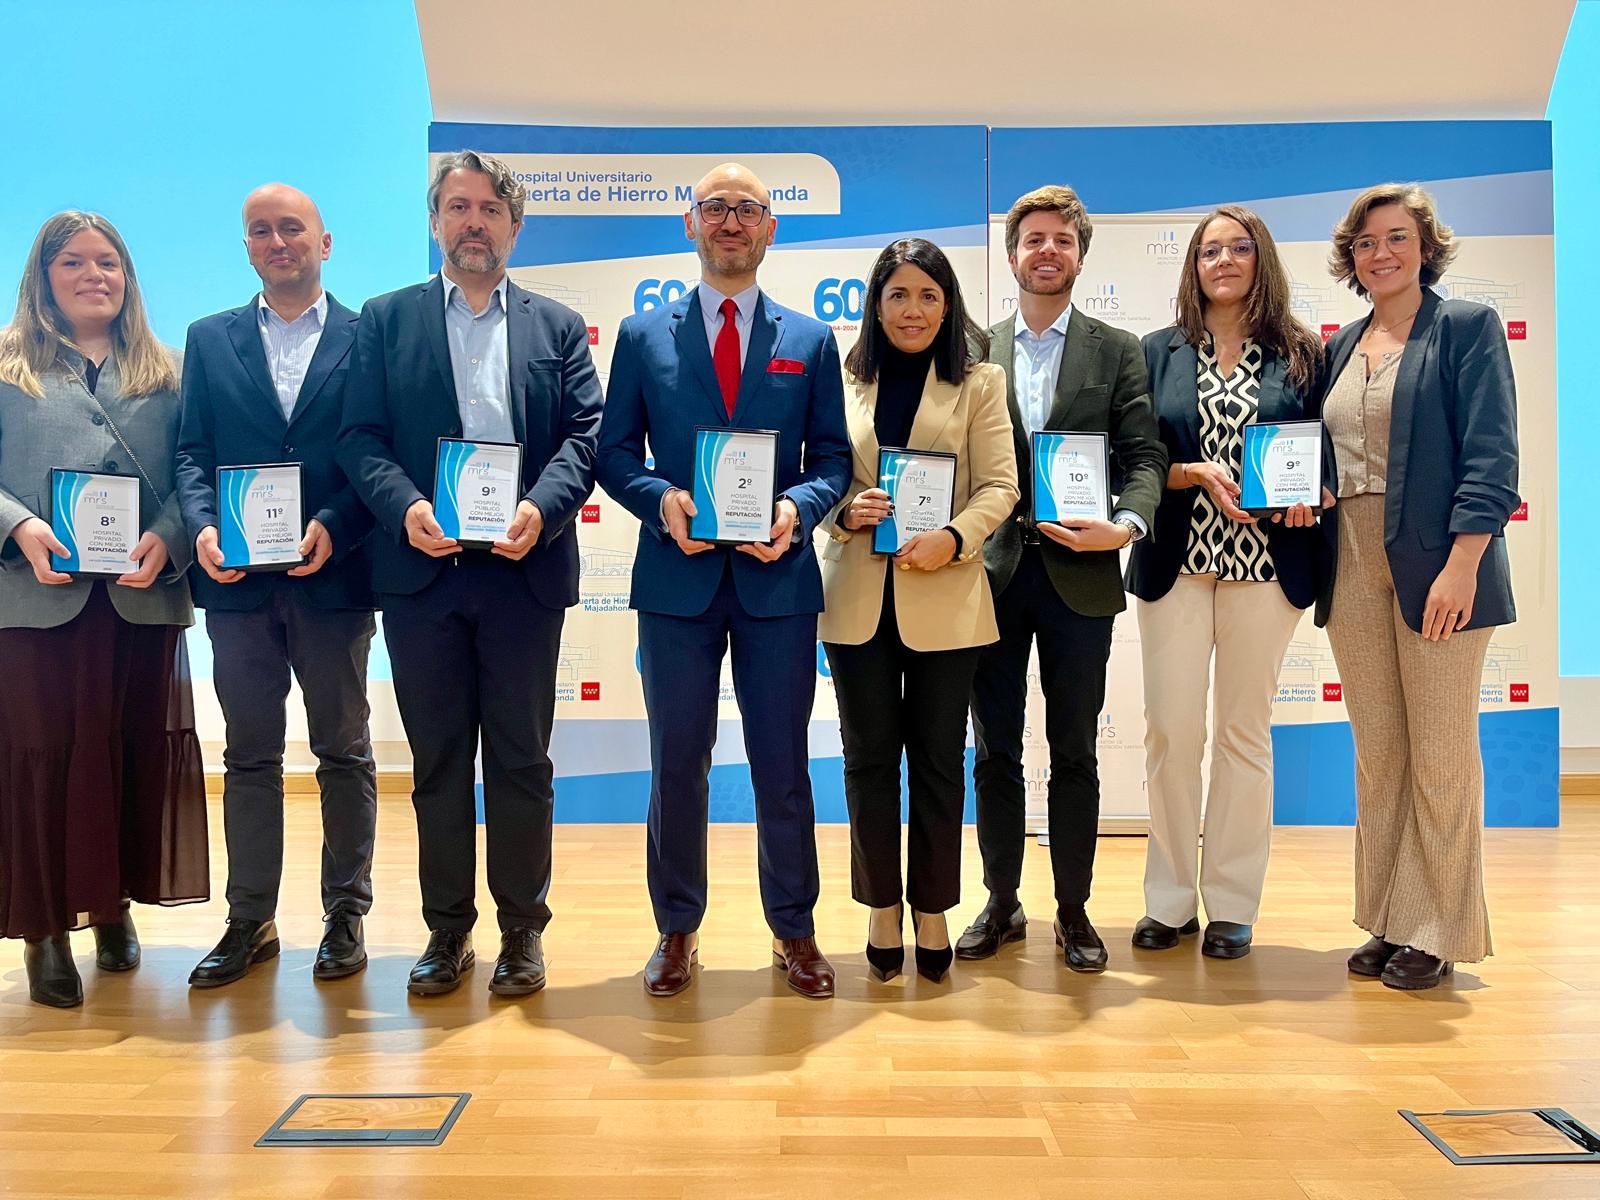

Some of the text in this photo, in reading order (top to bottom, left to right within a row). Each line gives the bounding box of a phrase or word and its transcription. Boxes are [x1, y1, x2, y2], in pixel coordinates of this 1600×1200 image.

[566, 171, 653, 183] Universitario
[577, 186, 601, 201] de
[608, 186, 668, 201] Hierro
[1146, 243, 1179, 255] mrs
[813, 277, 866, 322] 60
[1085, 297, 1119, 310] mrs
[1286, 460, 1300, 470] 9º
[1069, 472, 1088, 482] 10º
[738, 477, 752, 489] 2º
[481, 486, 496, 496] 9º
[918, 495, 931, 506] 7º
[265, 507, 283, 518] 11º
[100, 516, 116, 527] 8º
[580, 597, 630, 605] uerta de Hier
